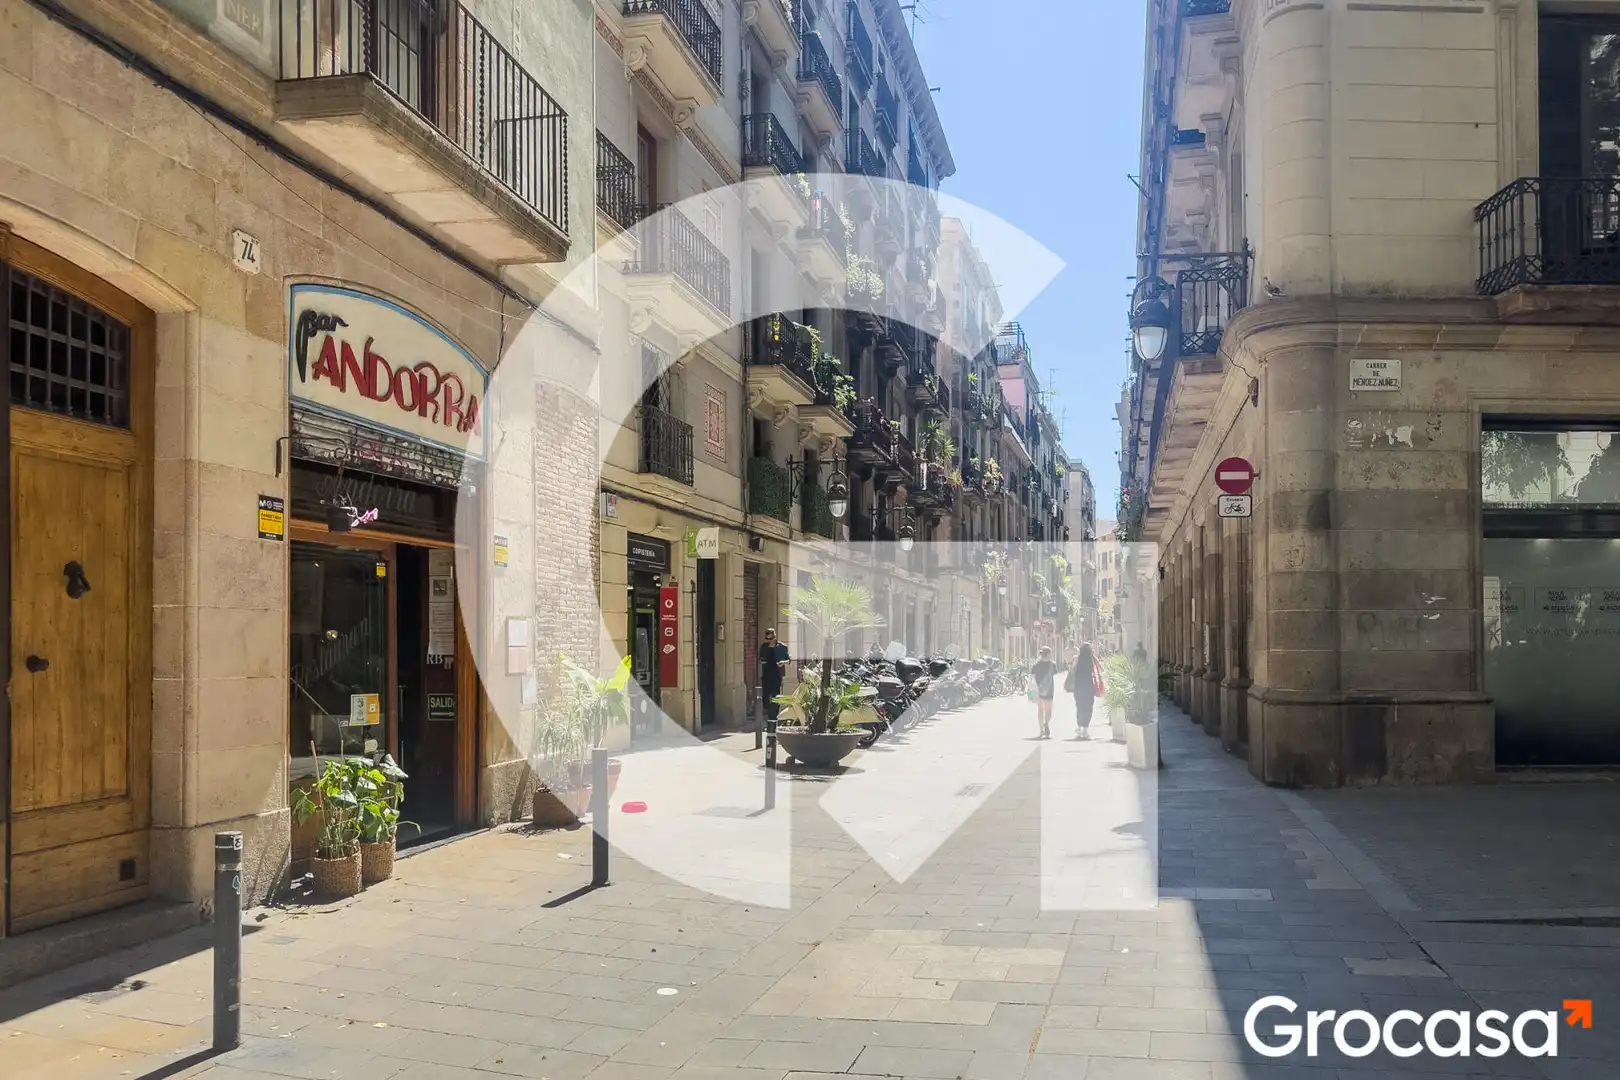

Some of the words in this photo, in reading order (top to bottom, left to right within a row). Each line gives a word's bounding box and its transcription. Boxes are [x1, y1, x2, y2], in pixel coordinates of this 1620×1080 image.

[241, 238, 256, 264] 74
[311, 334, 482, 434] ANDORRA
[697, 539, 717, 548] ATM
